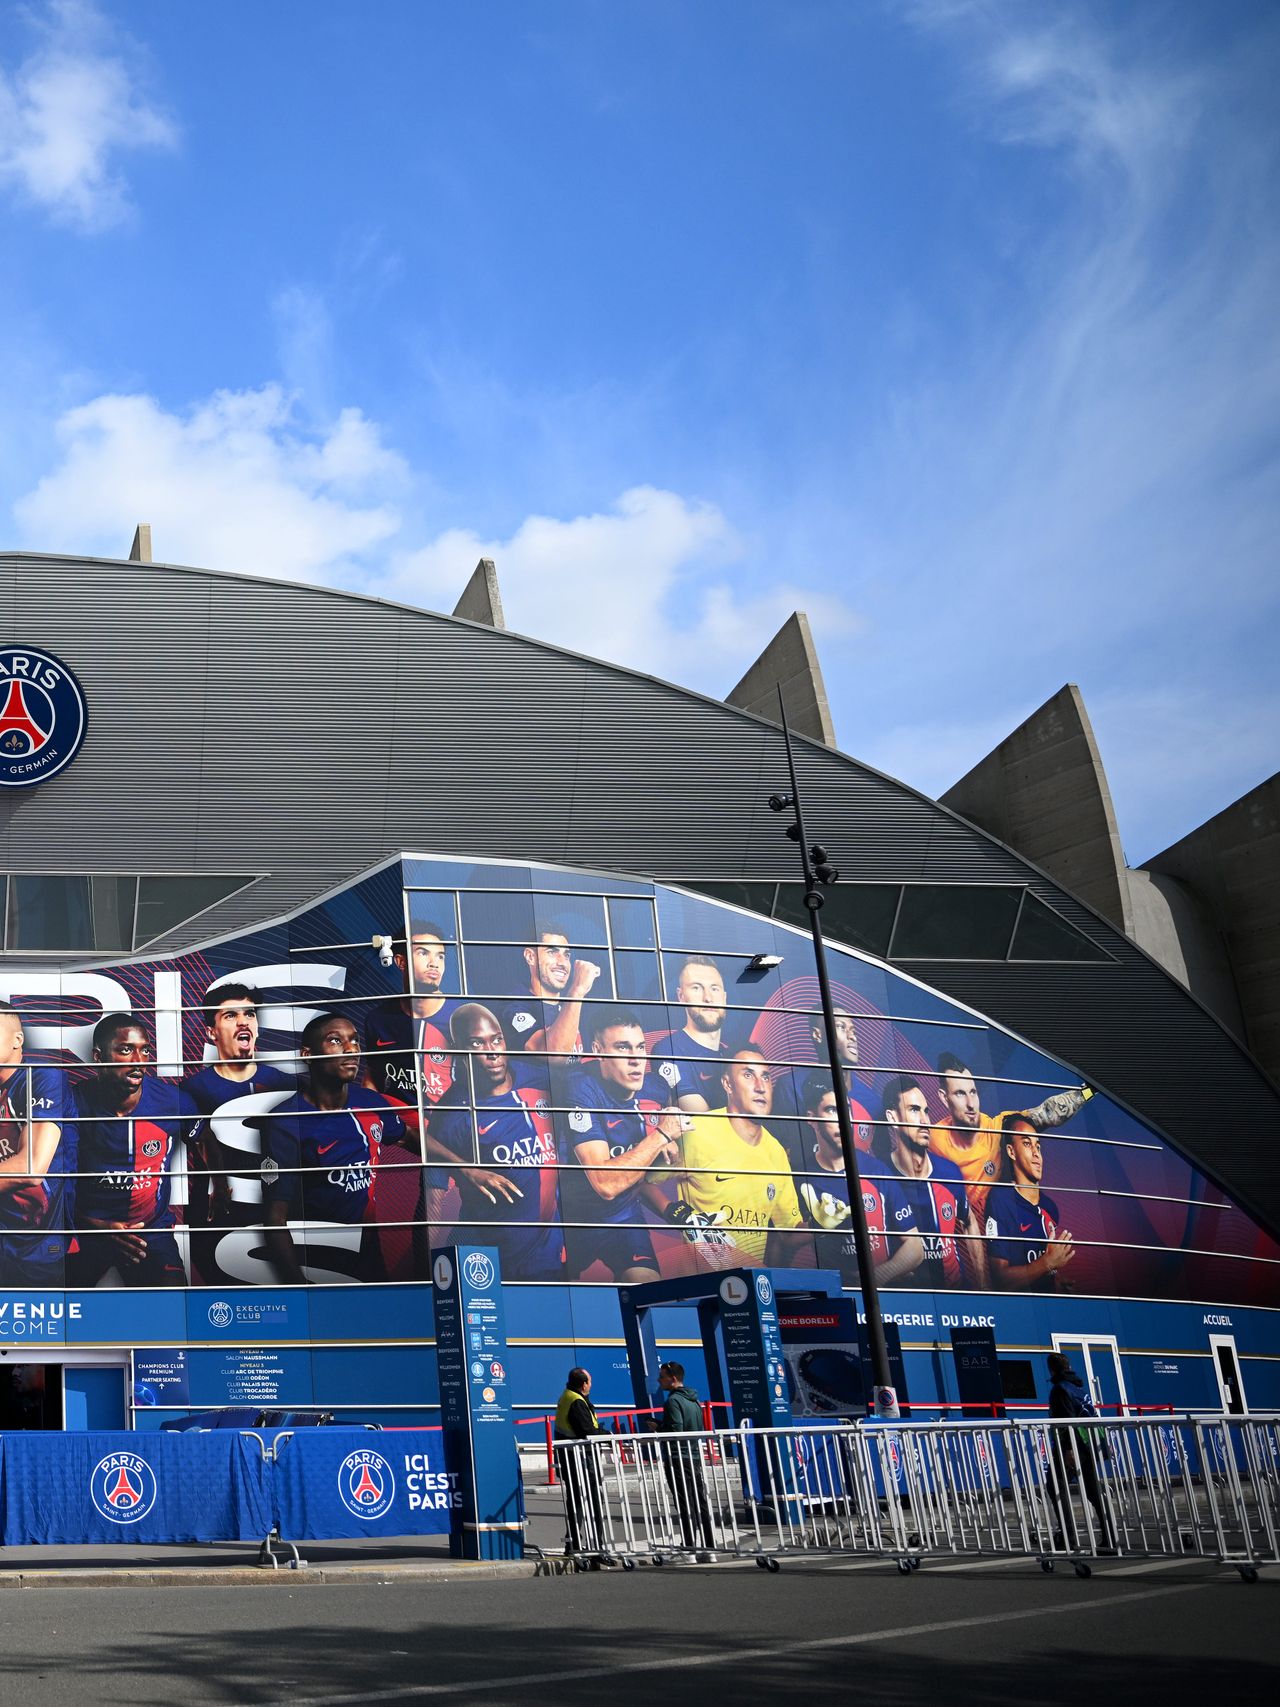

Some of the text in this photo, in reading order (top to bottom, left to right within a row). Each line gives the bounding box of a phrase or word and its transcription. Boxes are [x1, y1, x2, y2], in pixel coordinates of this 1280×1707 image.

[492, 1132, 555, 1165] QATAR
[727, 1282, 741, 1299] L
[941, 1315, 959, 1327] DU
[963, 1315, 996, 1327] PARC
[1203, 1315, 1233, 1326] ACCUEIL
[100, 1455, 144, 1473] PARIS
[345, 1453, 384, 1470] PARIS
[405, 1454, 429, 1472] ICI
